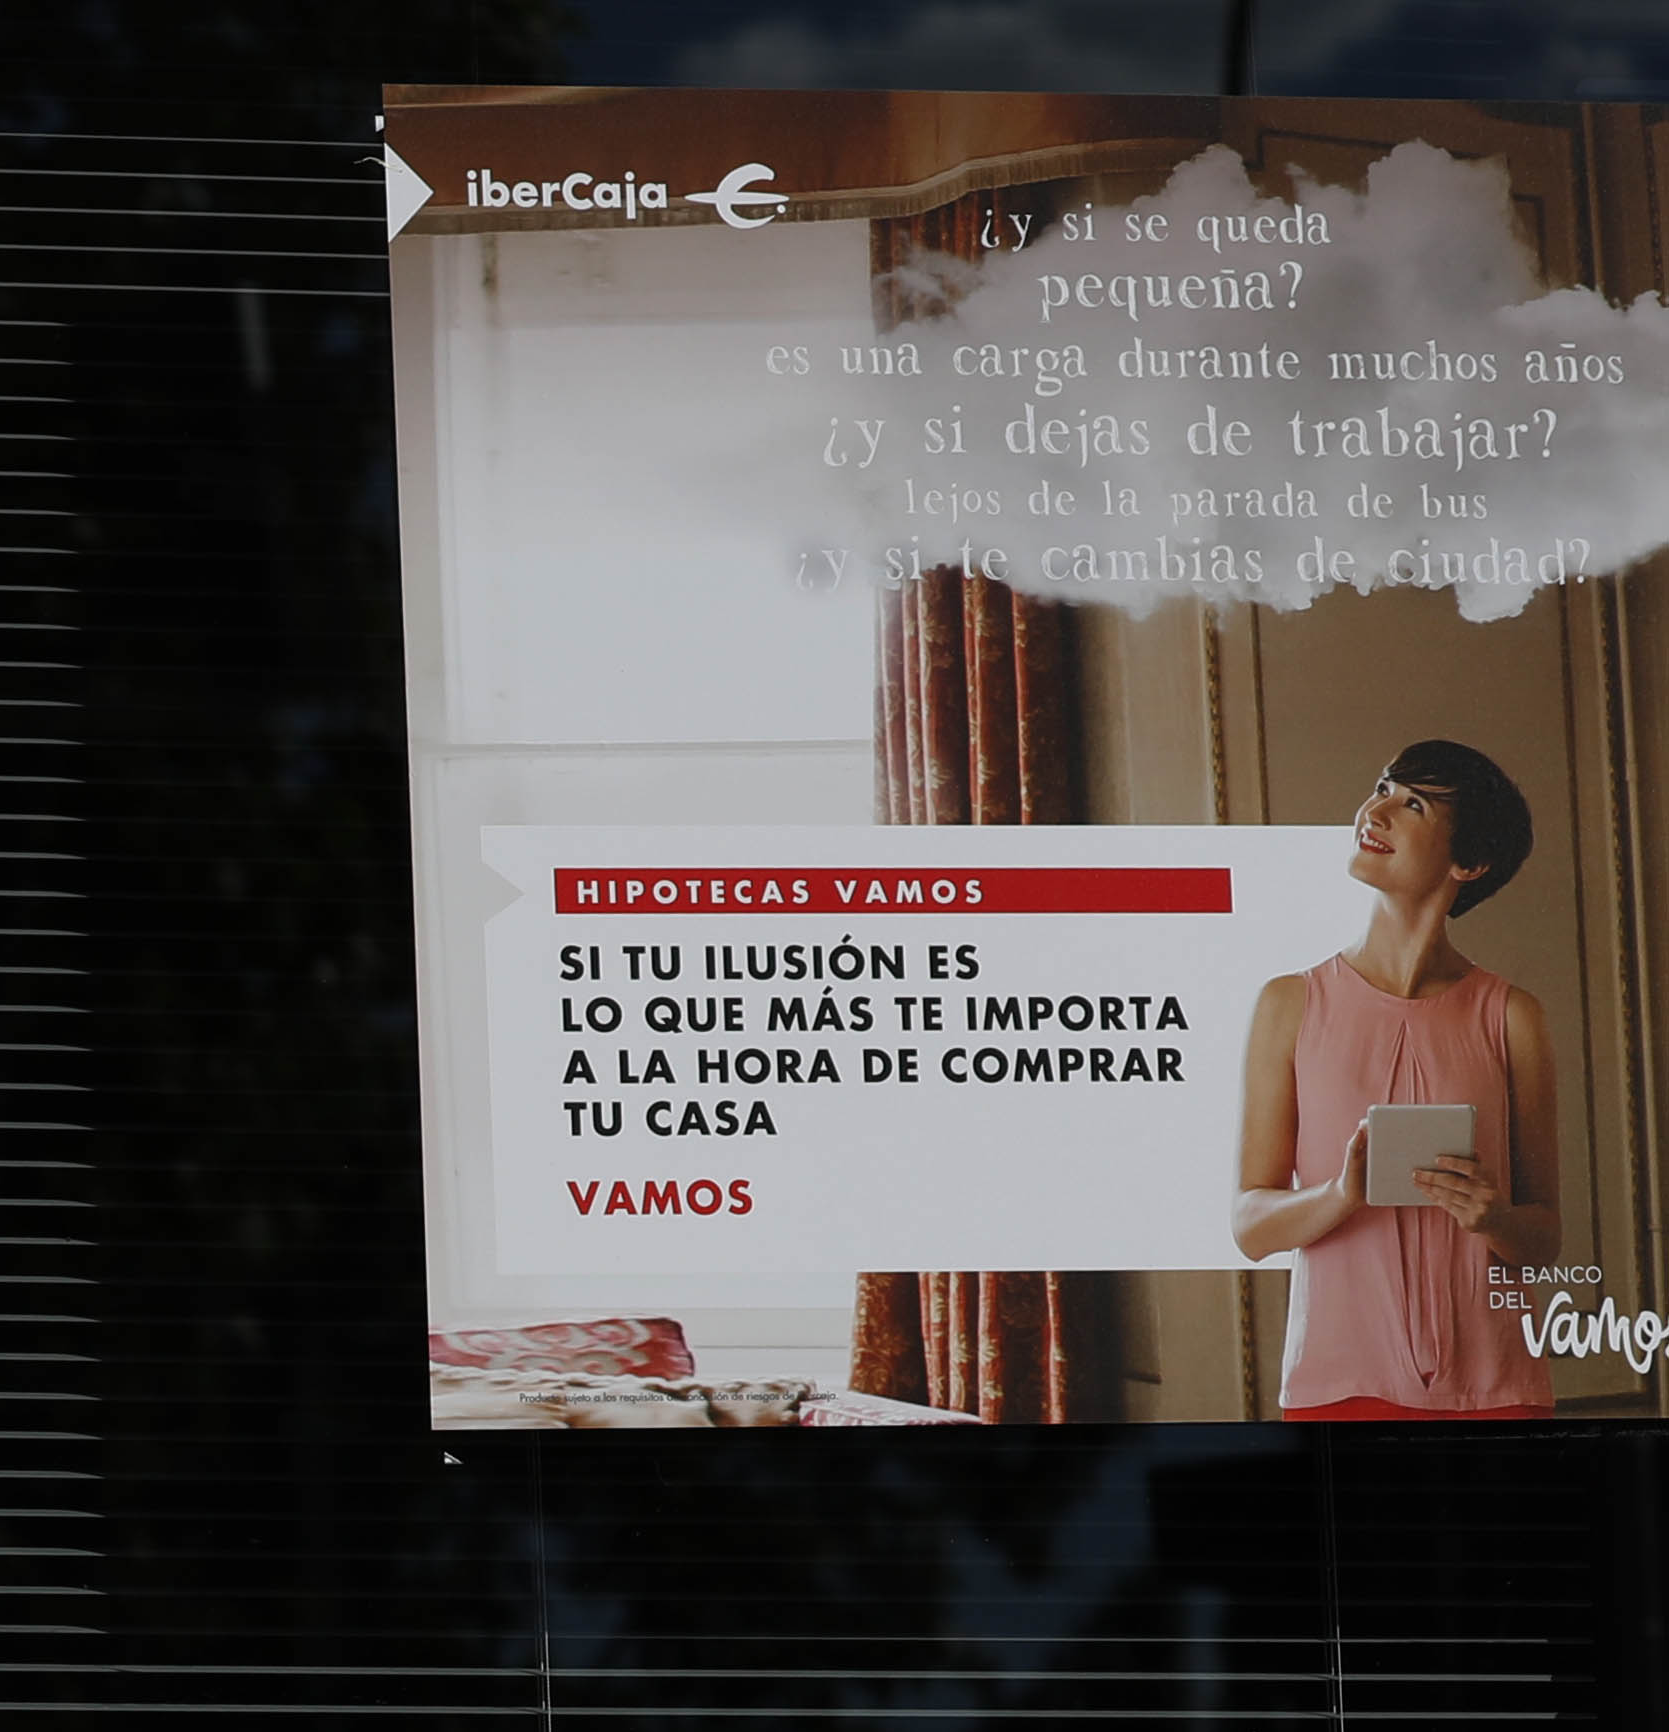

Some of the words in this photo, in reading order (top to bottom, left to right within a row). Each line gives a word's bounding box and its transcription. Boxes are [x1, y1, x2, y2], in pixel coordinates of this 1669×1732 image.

[467, 169, 667, 219] iberCaja
[981, 209, 1032, 251] ¿y
[1063, 203, 1095, 240] si
[1126, 214, 1168, 241] se
[1197, 204, 1330, 253] queda
[1038, 261, 1302, 321] pequeña?
[766, 346, 810, 375] es
[841, 344, 922, 376] una
[953, 344, 1087, 396] carga
[1119, 337, 1300, 379] durante
[1328, 340, 1497, 382] muchos
[1525, 344, 1623, 383] años
[824, 417, 886, 468] ¿y
[925, 405, 966, 453] si
[1005, 403, 1149, 467] dejas
[1187, 405, 1251, 456] de
[1288, 407, 1556, 471] trabajar?
[905, 478, 1000, 524] lejos
[1028, 480, 1075, 515] de
[1102, 480, 1140, 516] la
[1171, 482, 1318, 524] parada
[1348, 483, 1392, 518] de
[1420, 483, 1487, 519] bus
[885, 534, 925, 581] si
[961, 539, 1006, 580] te
[1040, 536, 1263, 586] cambias
[1297, 536, 1356, 584] de
[1384, 537, 1590, 588] ciudad?
[578, 880, 808, 904] HIPOTECAS
[835, 880, 981, 903] VAMOS
[560, 945, 600, 981] SI
[623, 946, 680, 980] TU
[706, 934, 904, 980] ILUSIÓN
[929, 945, 979, 980] ES
[562, 997, 622, 1032] LO
[645, 997, 743, 1033] QUE
[768, 986, 873, 1031] MÁS
[894, 997, 942, 1031] TE
[967, 996, 1188, 1031] IMPORTA
[563, 1050, 596, 1084] A
[619, 1050, 675, 1083] LA
[698, 1048, 840, 1084] HORA
[863, 1049, 918, 1082] DE
[942, 1048, 1184, 1083] COMPRAR
[564, 1102, 622, 1136] TU
[646, 1101, 777, 1136] CASA
[567, 1179, 752, 1215] VAMOS
[1489, 1267, 1514, 1284] EL
[1522, 1266, 1602, 1283] BANCO
[1490, 1292, 1532, 1309] DEL
